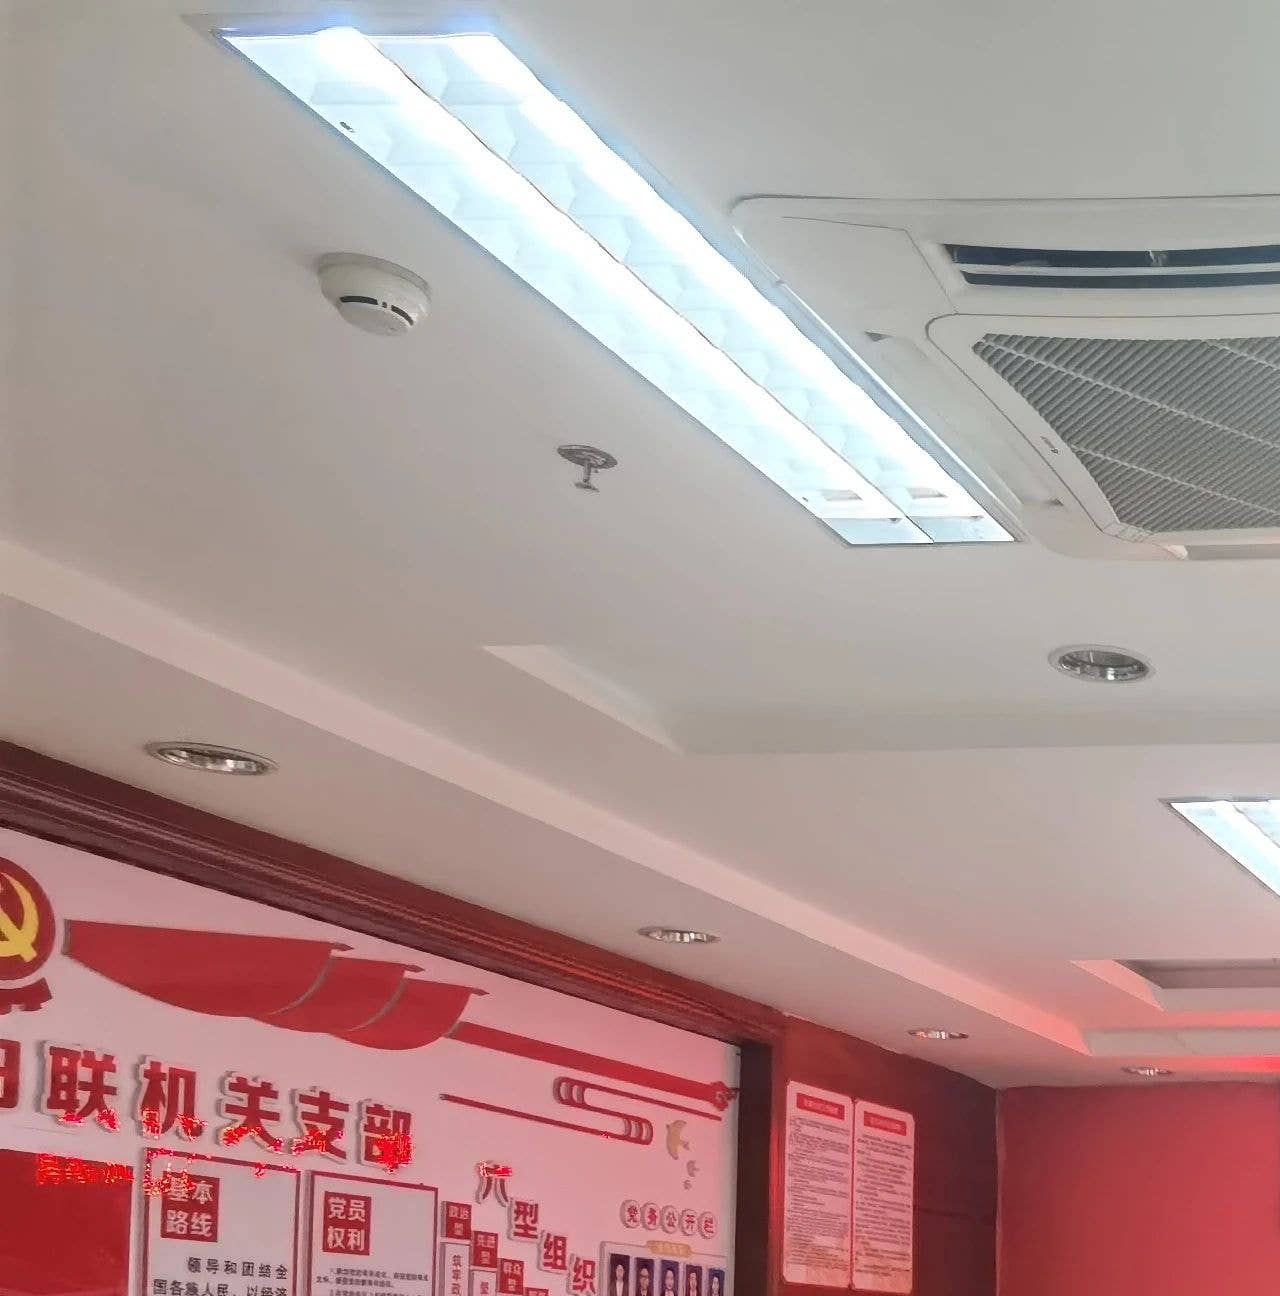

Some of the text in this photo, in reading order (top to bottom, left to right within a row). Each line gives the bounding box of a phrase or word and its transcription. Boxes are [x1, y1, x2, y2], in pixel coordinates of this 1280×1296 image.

[328, 1196, 366, 1222] 党员
[166, 1210, 213, 1237] 路线
[326, 1225, 366, 1252] 权利
